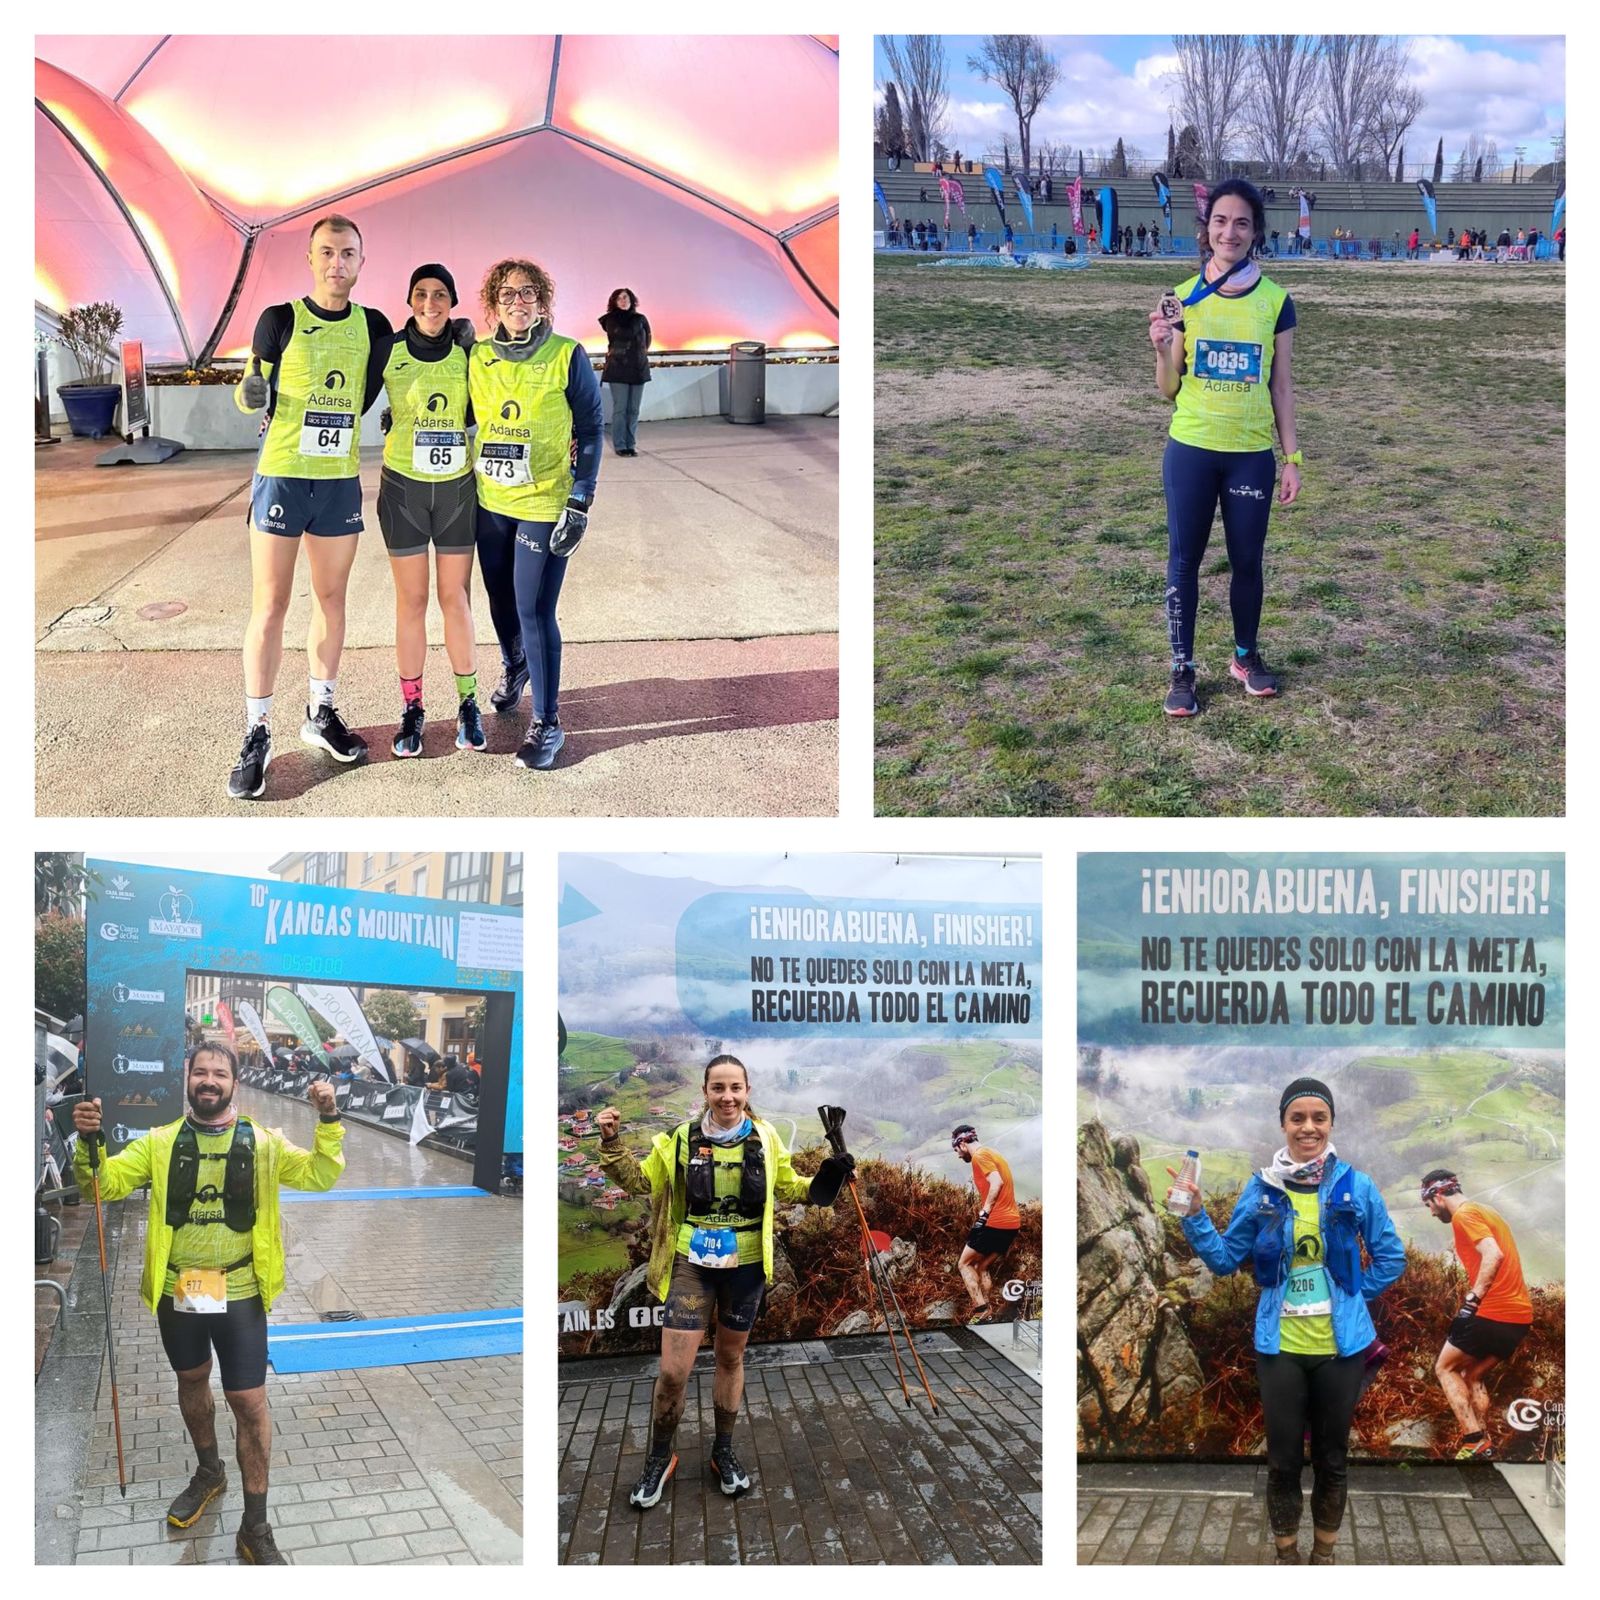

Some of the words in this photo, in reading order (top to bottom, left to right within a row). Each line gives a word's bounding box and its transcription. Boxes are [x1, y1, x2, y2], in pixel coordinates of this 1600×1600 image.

[1207, 350, 1249, 370] 0835
[1203, 380, 1251, 392] Adarsa
[307, 393, 352, 408] Adarsa
[413, 416, 454, 428] Adarsa
[489, 423, 531, 438] Adarsa
[318, 429, 341, 447] 64
[430, 447, 452, 465] 65
[485, 459, 515, 478] 973
[1141, 868, 1390, 919] ¡ENHORABUENA,
[1400, 869, 1551, 915] FINISHER!
[153, 922, 199, 936] MAYADOR
[265, 898, 352, 944] KANGAS
[357, 907, 454, 960] MOUNTAIN
[750, 906, 928, 948] ¡ENHORABUENA,
[933, 913, 1033, 946] FINISHER!
[1141, 936, 1172, 972] NO
[1180, 936, 1208, 972] TE
[1216, 936, 1301, 976] QUEDES
[1309, 936, 1366, 972] SOLO
[1374, 936, 1421, 972] CON
[1429, 936, 1459, 973] LA
[1467, 937, 1547, 977] META,
[751, 956, 774, 983] NO
[779, 957, 801, 983] TE
[806, 957, 867, 987] QUEDES
[872, 959, 912, 985] SOLO
[918, 960, 950, 986] CON
[955, 961, 975, 986] LA
[980, 961, 1032, 990] META,
[751, 989, 861, 1023] RECUERDA
[868, 991, 920, 1023] TODO
[926, 992, 949, 1023] EL
[954, 992, 1031, 1024] CAMINO
[1141, 980, 1290, 1025] RECUERDA
[1300, 981, 1375, 1026] TODO
[1385, 981, 1417, 1026] EL
[1427, 981, 1546, 1027] CAMINO
[191, 1208, 222, 1220] darsa
[703, 1236, 722, 1250] 3104
[186, 1280, 203, 1291] 577
[1291, 1278, 1315, 1292] 2206
[558, 1309, 616, 1332] AIN.ES
[1543, 1399, 1565, 1412] Can
[1543, 1413, 1556, 1426] de
[1556, 1412, 1565, 1426] O
